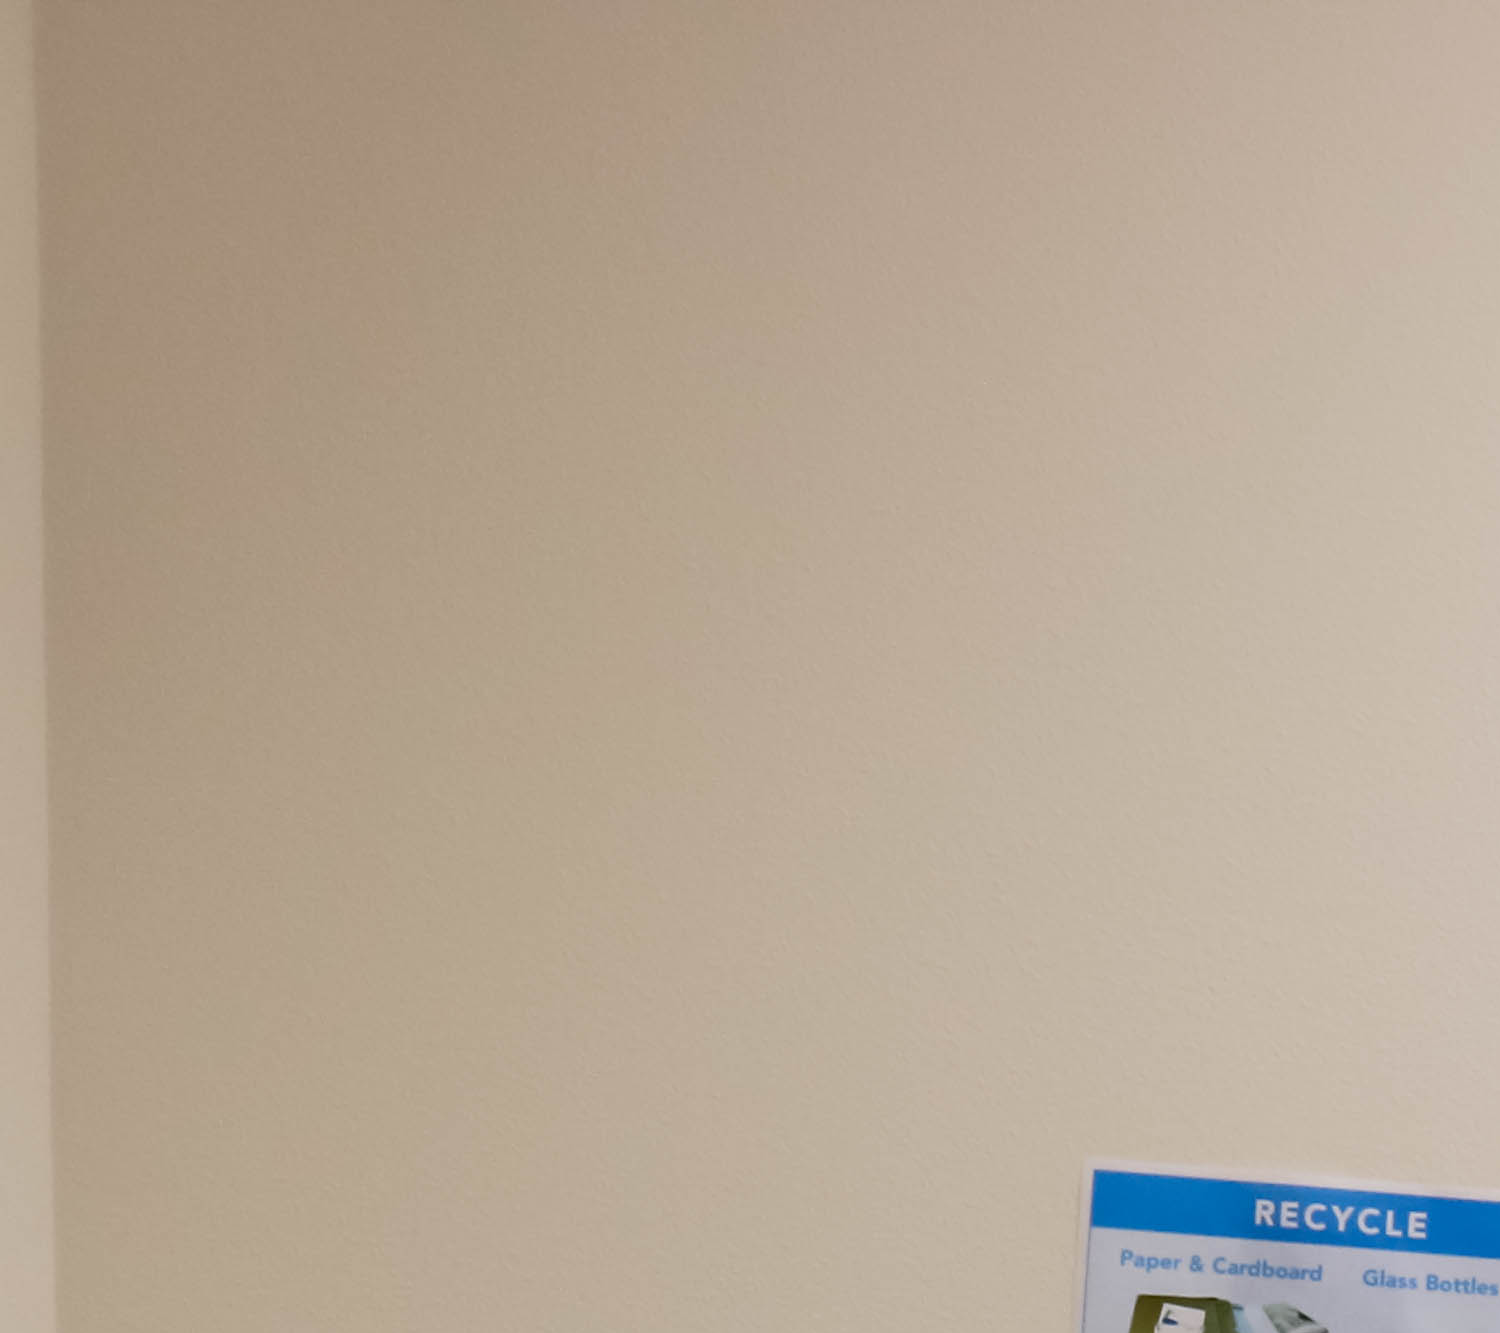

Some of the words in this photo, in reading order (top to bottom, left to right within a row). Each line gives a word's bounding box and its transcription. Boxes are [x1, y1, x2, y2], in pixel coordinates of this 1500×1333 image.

[1254, 1198, 1428, 1239] RECYCLE
[1119, 1248, 1181, 1273] Paper
[1188, 1254, 1204, 1273] &
[1211, 1255, 1323, 1282] Cardboard
[1361, 1267, 1418, 1289] Glass
[1424, 1272, 1499, 1297] Bottles
